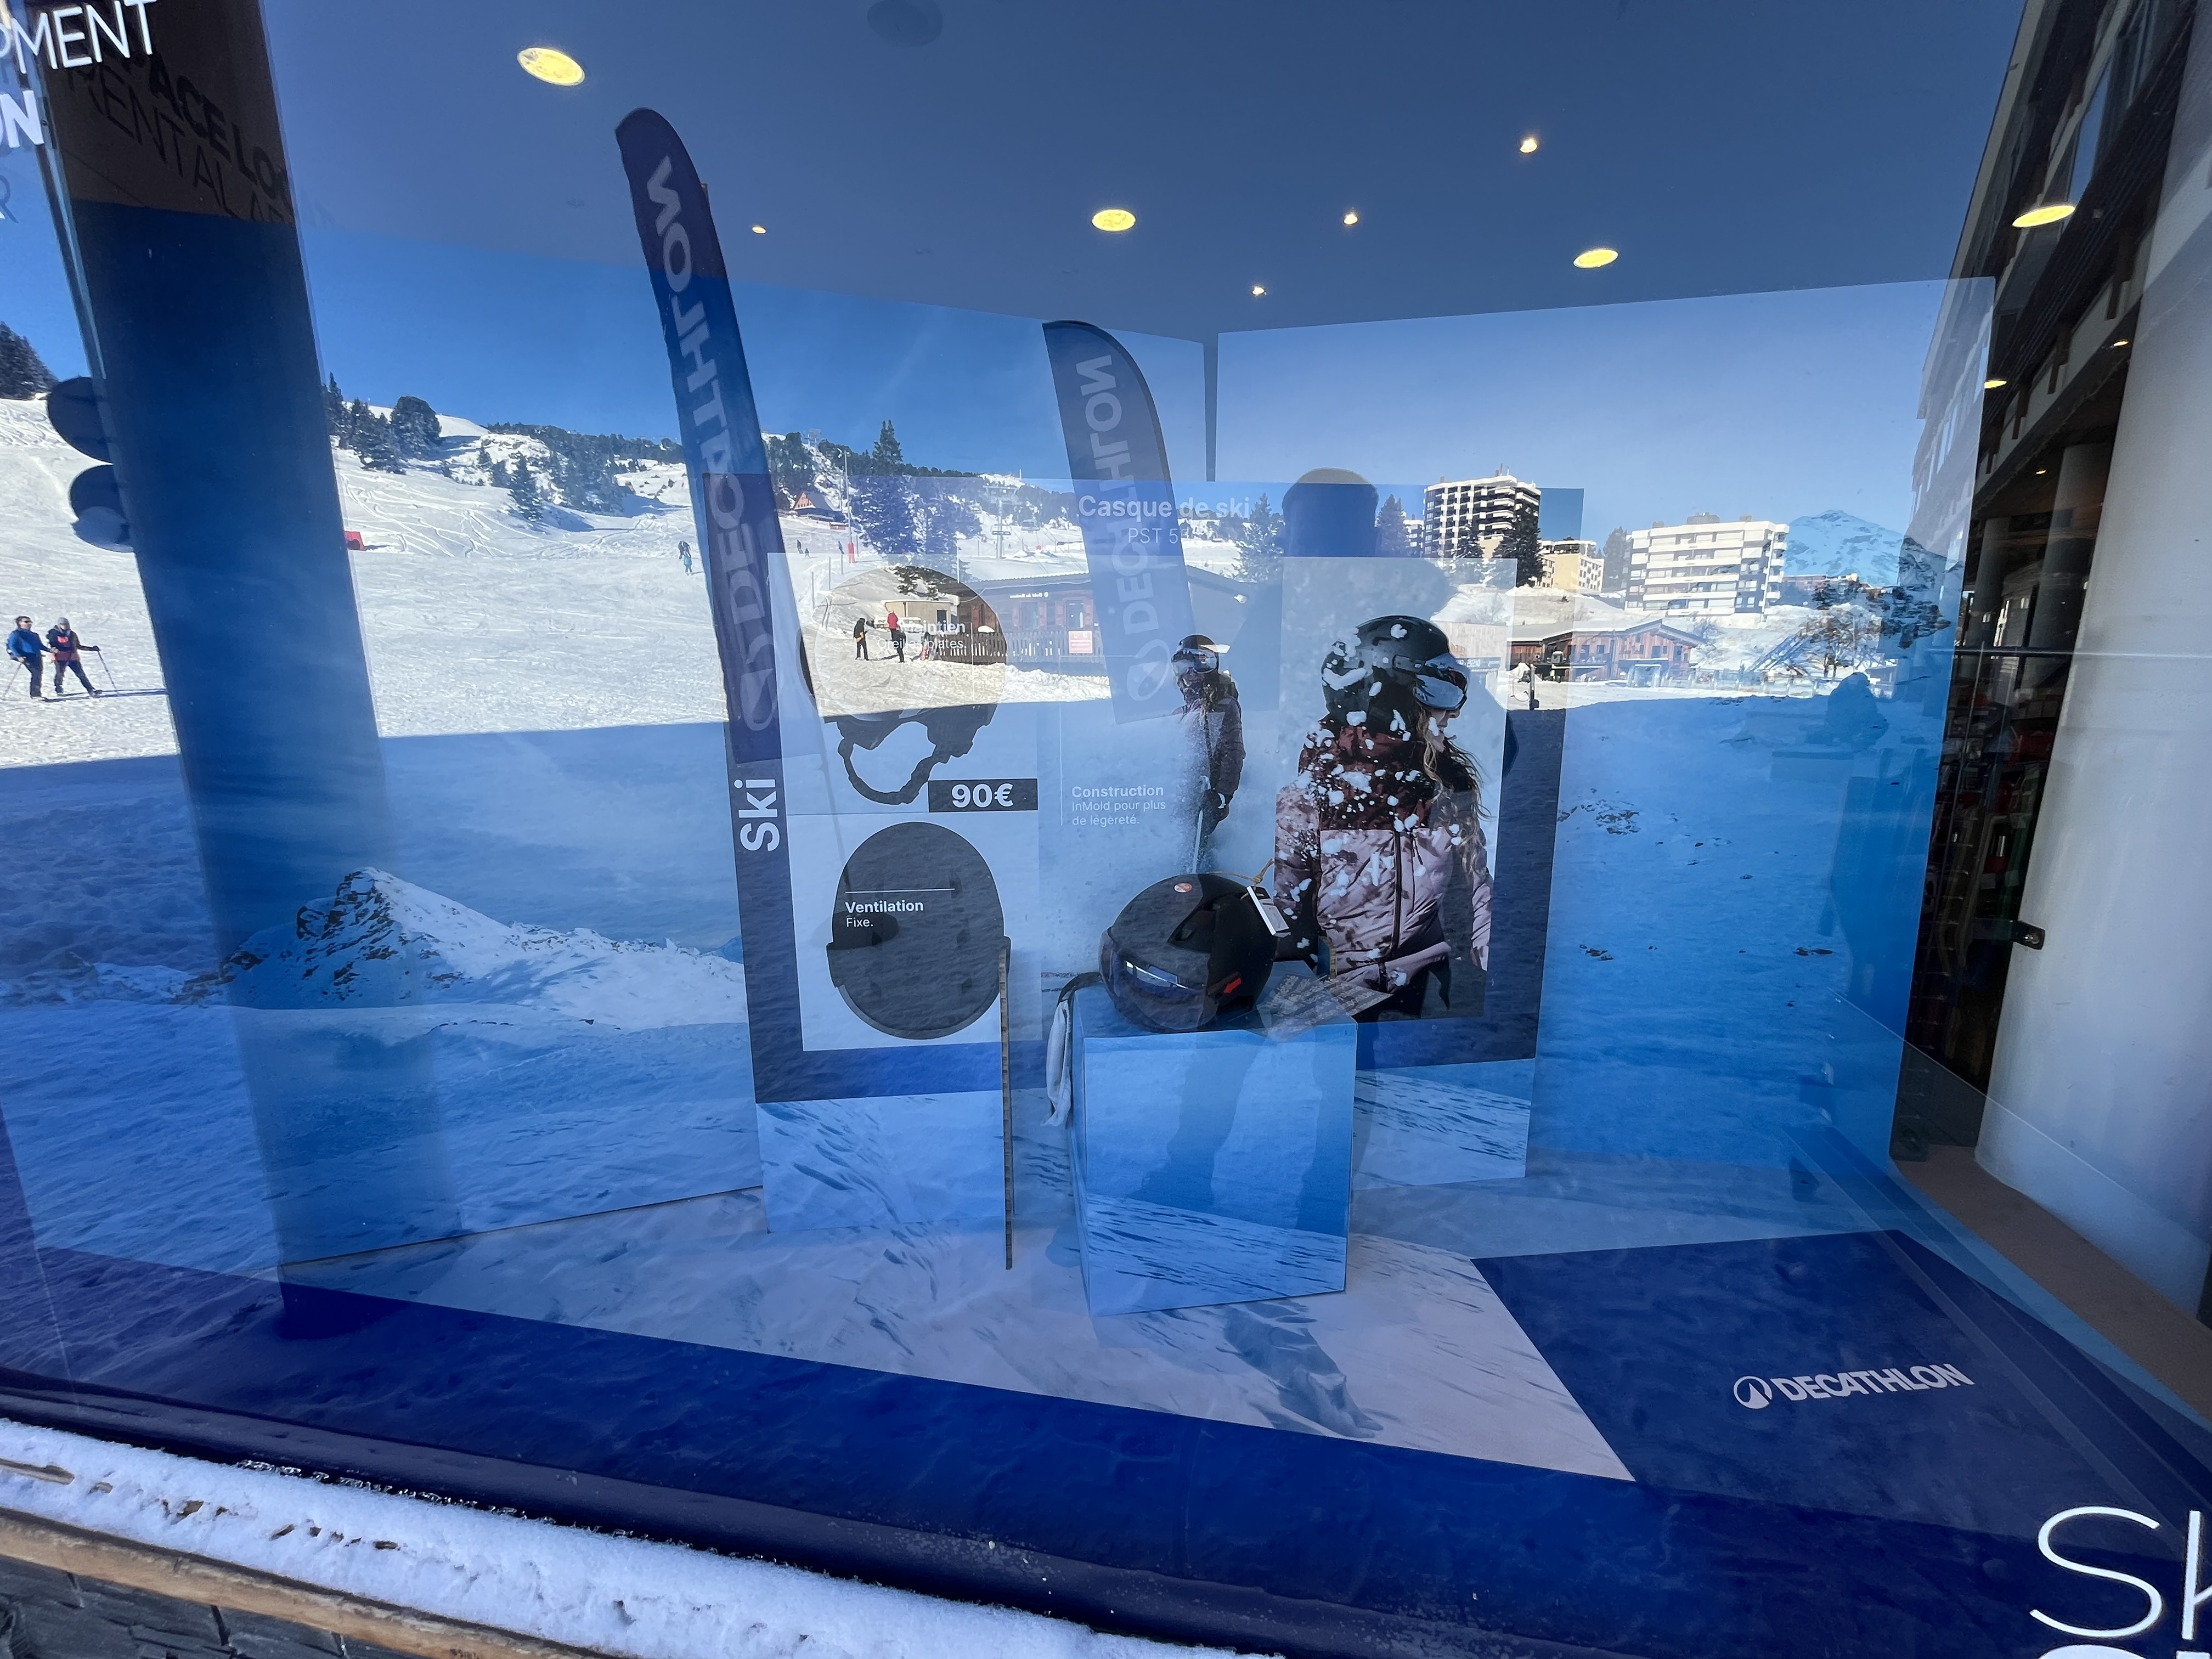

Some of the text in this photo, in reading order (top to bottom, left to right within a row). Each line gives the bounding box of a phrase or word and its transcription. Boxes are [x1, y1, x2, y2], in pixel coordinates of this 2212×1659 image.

[1079, 495, 1250, 522] Casque de ski
[1128, 528, 1162, 544] PST
[877, 637, 924, 649] Oreil
[952, 783, 1014, 808] 90€
[1072, 785, 1164, 798] Construction
[1072, 799, 1166, 812] InMold pour plus
[734, 778, 780, 851] Ski
[1072, 816, 1086, 825] de
[845, 900, 924, 914] Ventilation
[846, 917, 874, 928] Fixe.
[1770, 1363, 1975, 1401] DECATHLON
